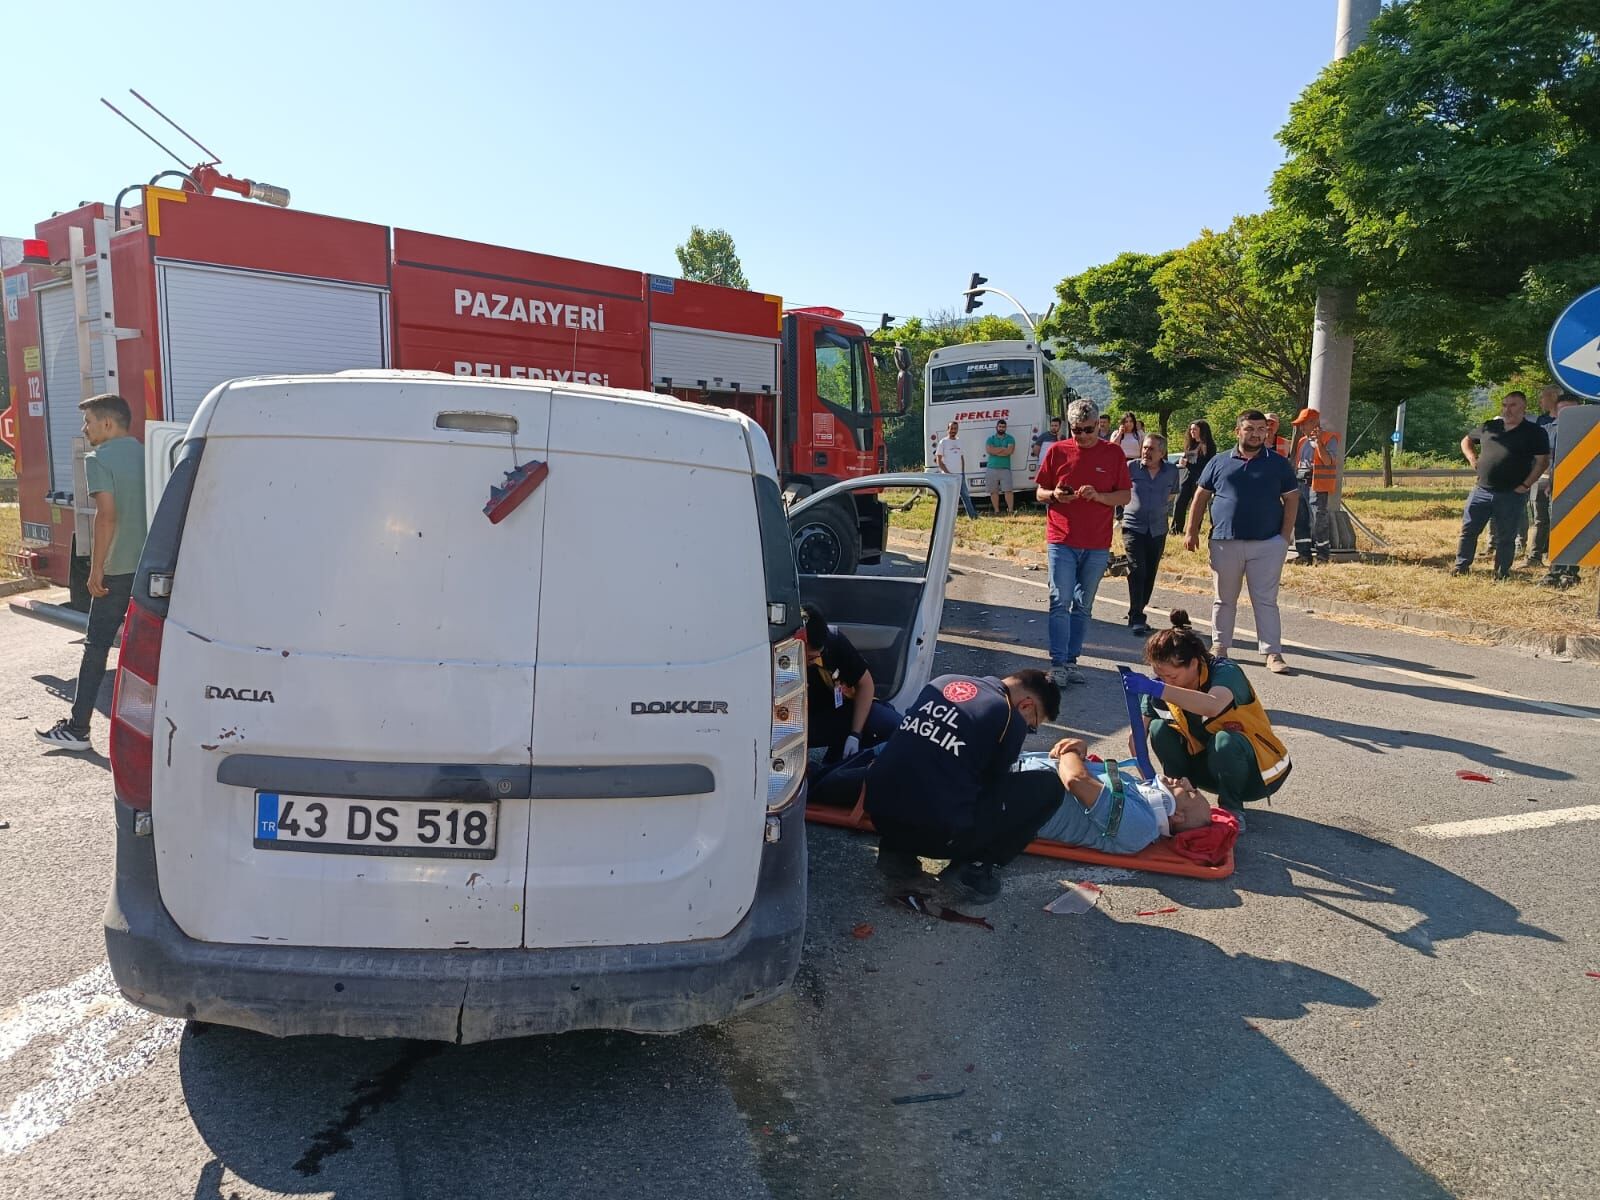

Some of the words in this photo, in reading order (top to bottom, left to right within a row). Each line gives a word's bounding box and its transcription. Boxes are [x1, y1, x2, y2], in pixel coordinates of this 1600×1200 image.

[454, 288, 605, 333] PAZARYERİ
[28, 376, 41, 399] 112
[204, 685, 275, 703] DACIA
[631, 701, 729, 715] DOKKER
[919, 700, 960, 729] ACİL
[899, 715, 967, 757] SAĞLIK
[261, 821, 276, 831] TR
[277, 801, 329, 839] 43
[347, 805, 400, 842] DS
[417, 808, 488, 846] 518
